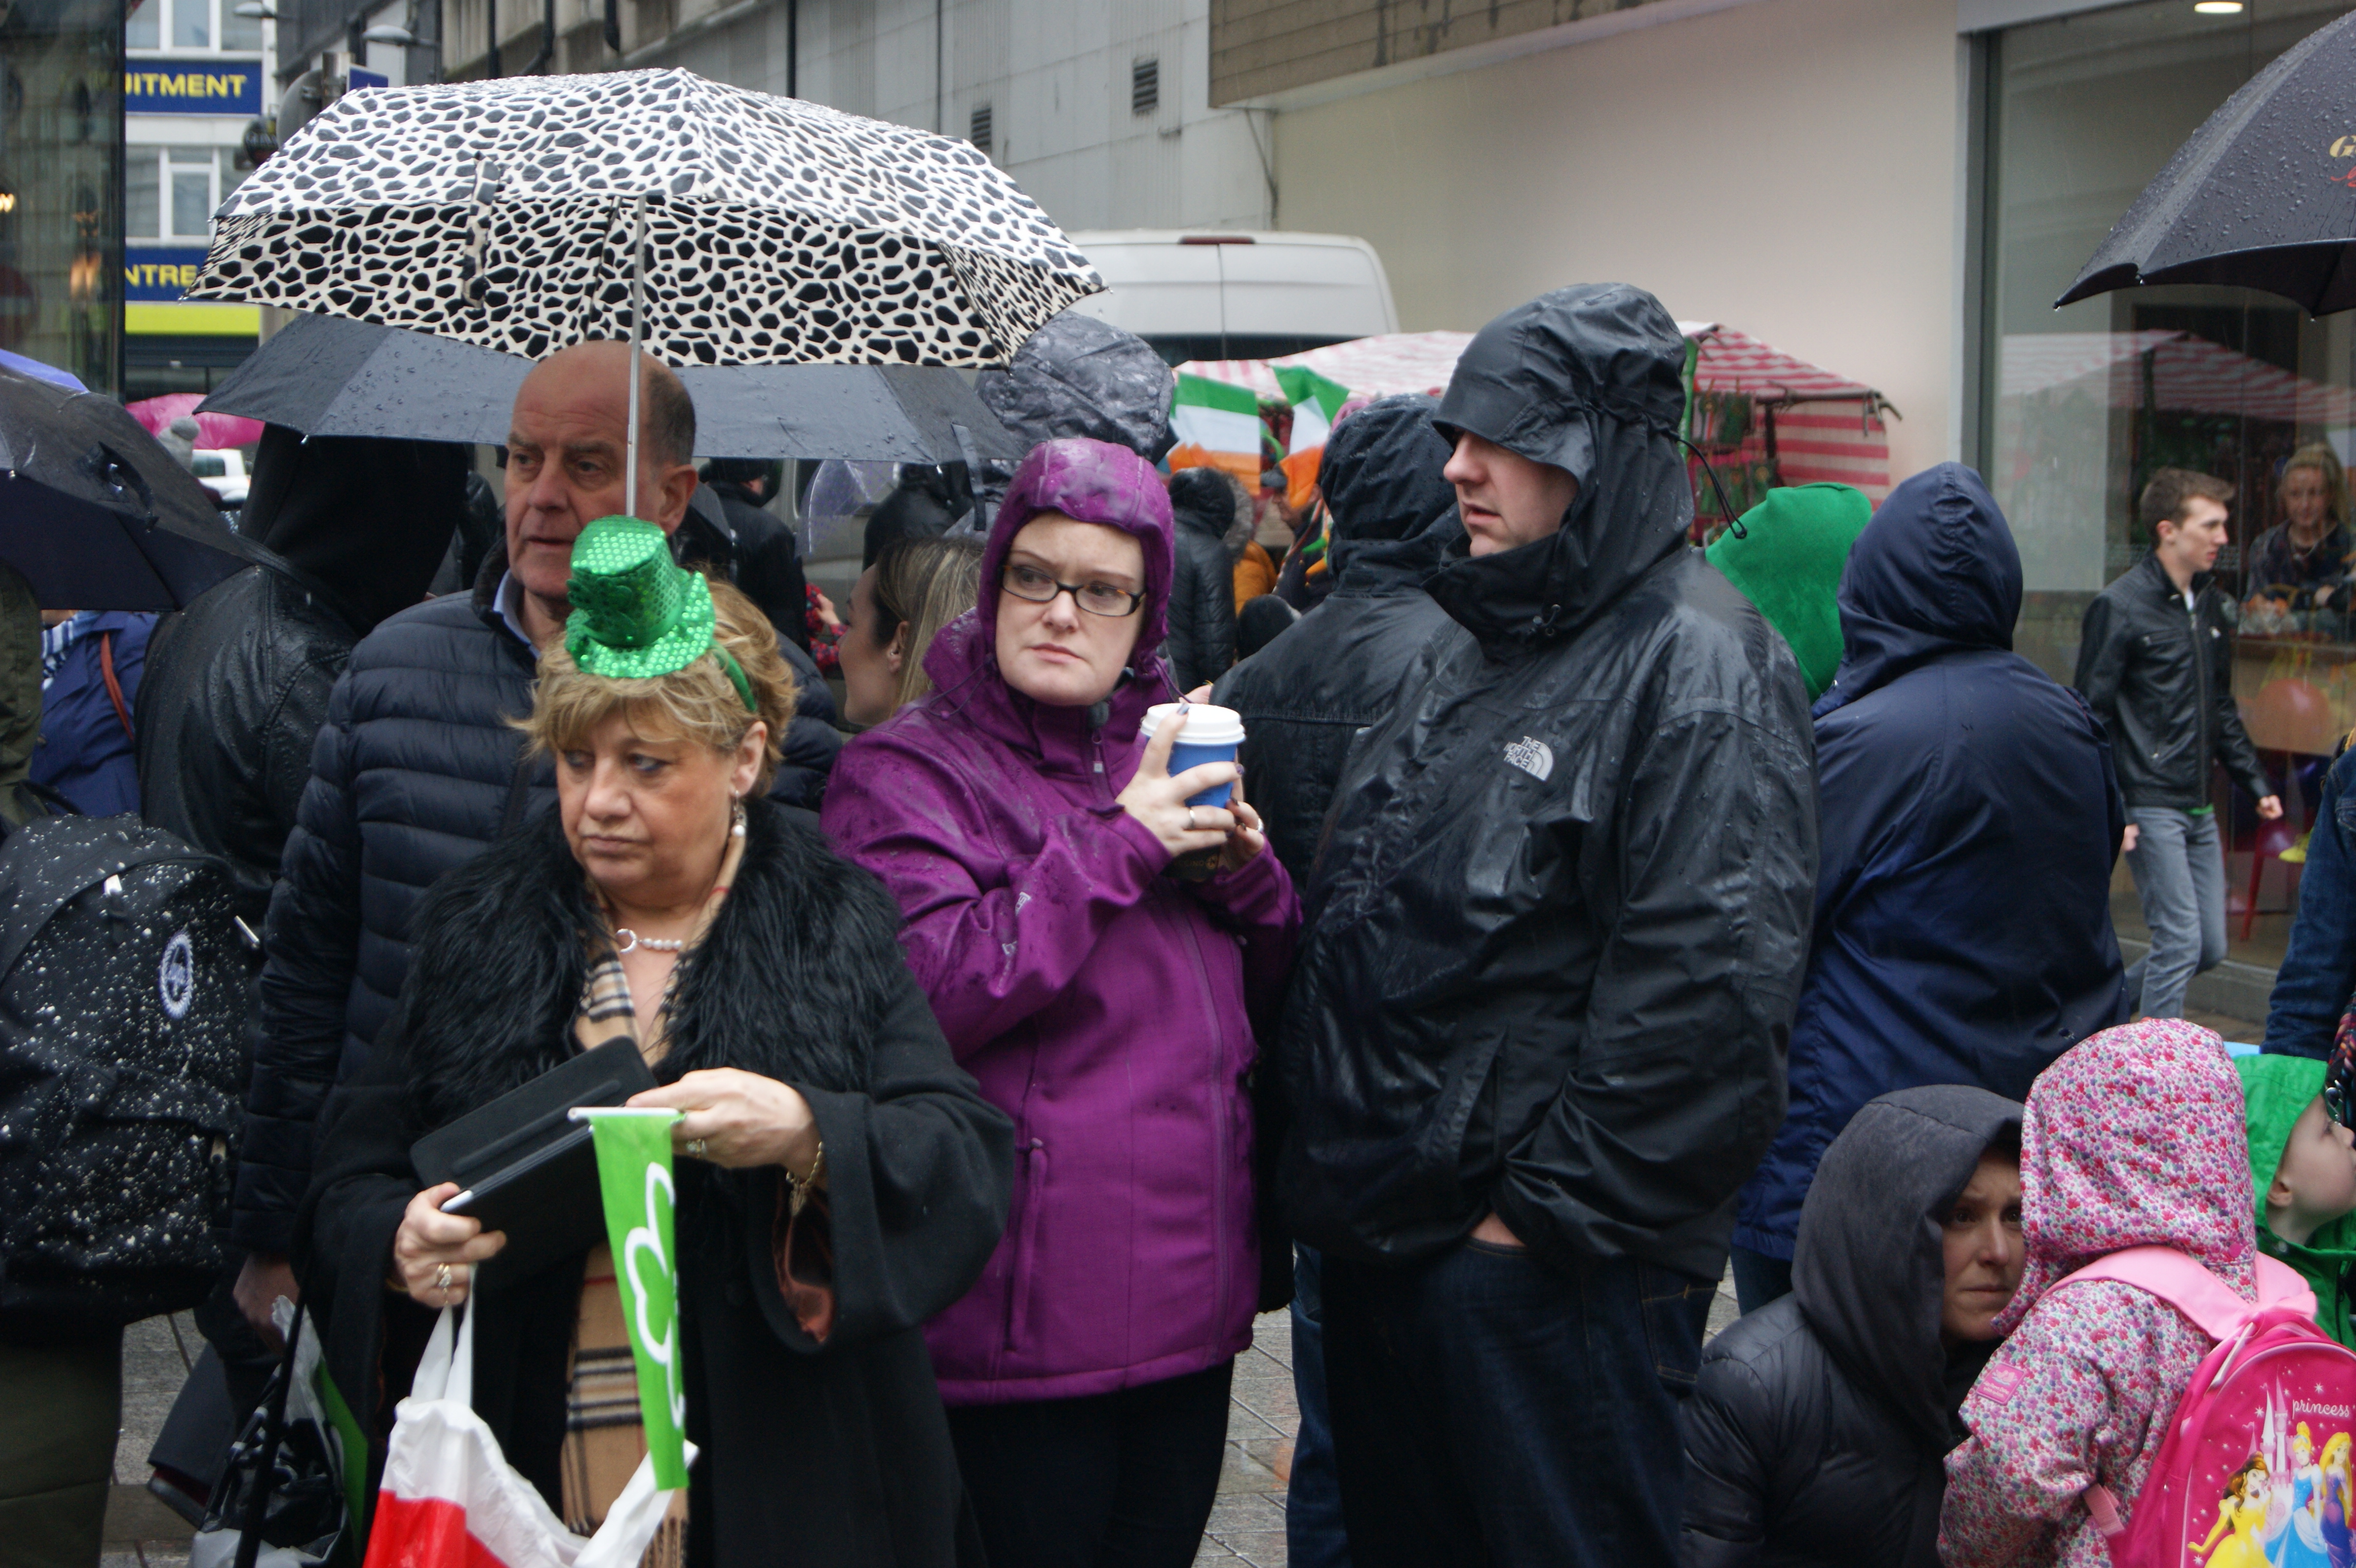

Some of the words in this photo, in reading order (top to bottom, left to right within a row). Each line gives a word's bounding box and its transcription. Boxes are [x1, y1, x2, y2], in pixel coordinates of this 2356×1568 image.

[1503, 741, 1536, 761] NORTH
[1521, 735, 1541, 751] THE
[1503, 752, 1530, 769] FACE
[2292, 1398, 2349, 1420] princess
